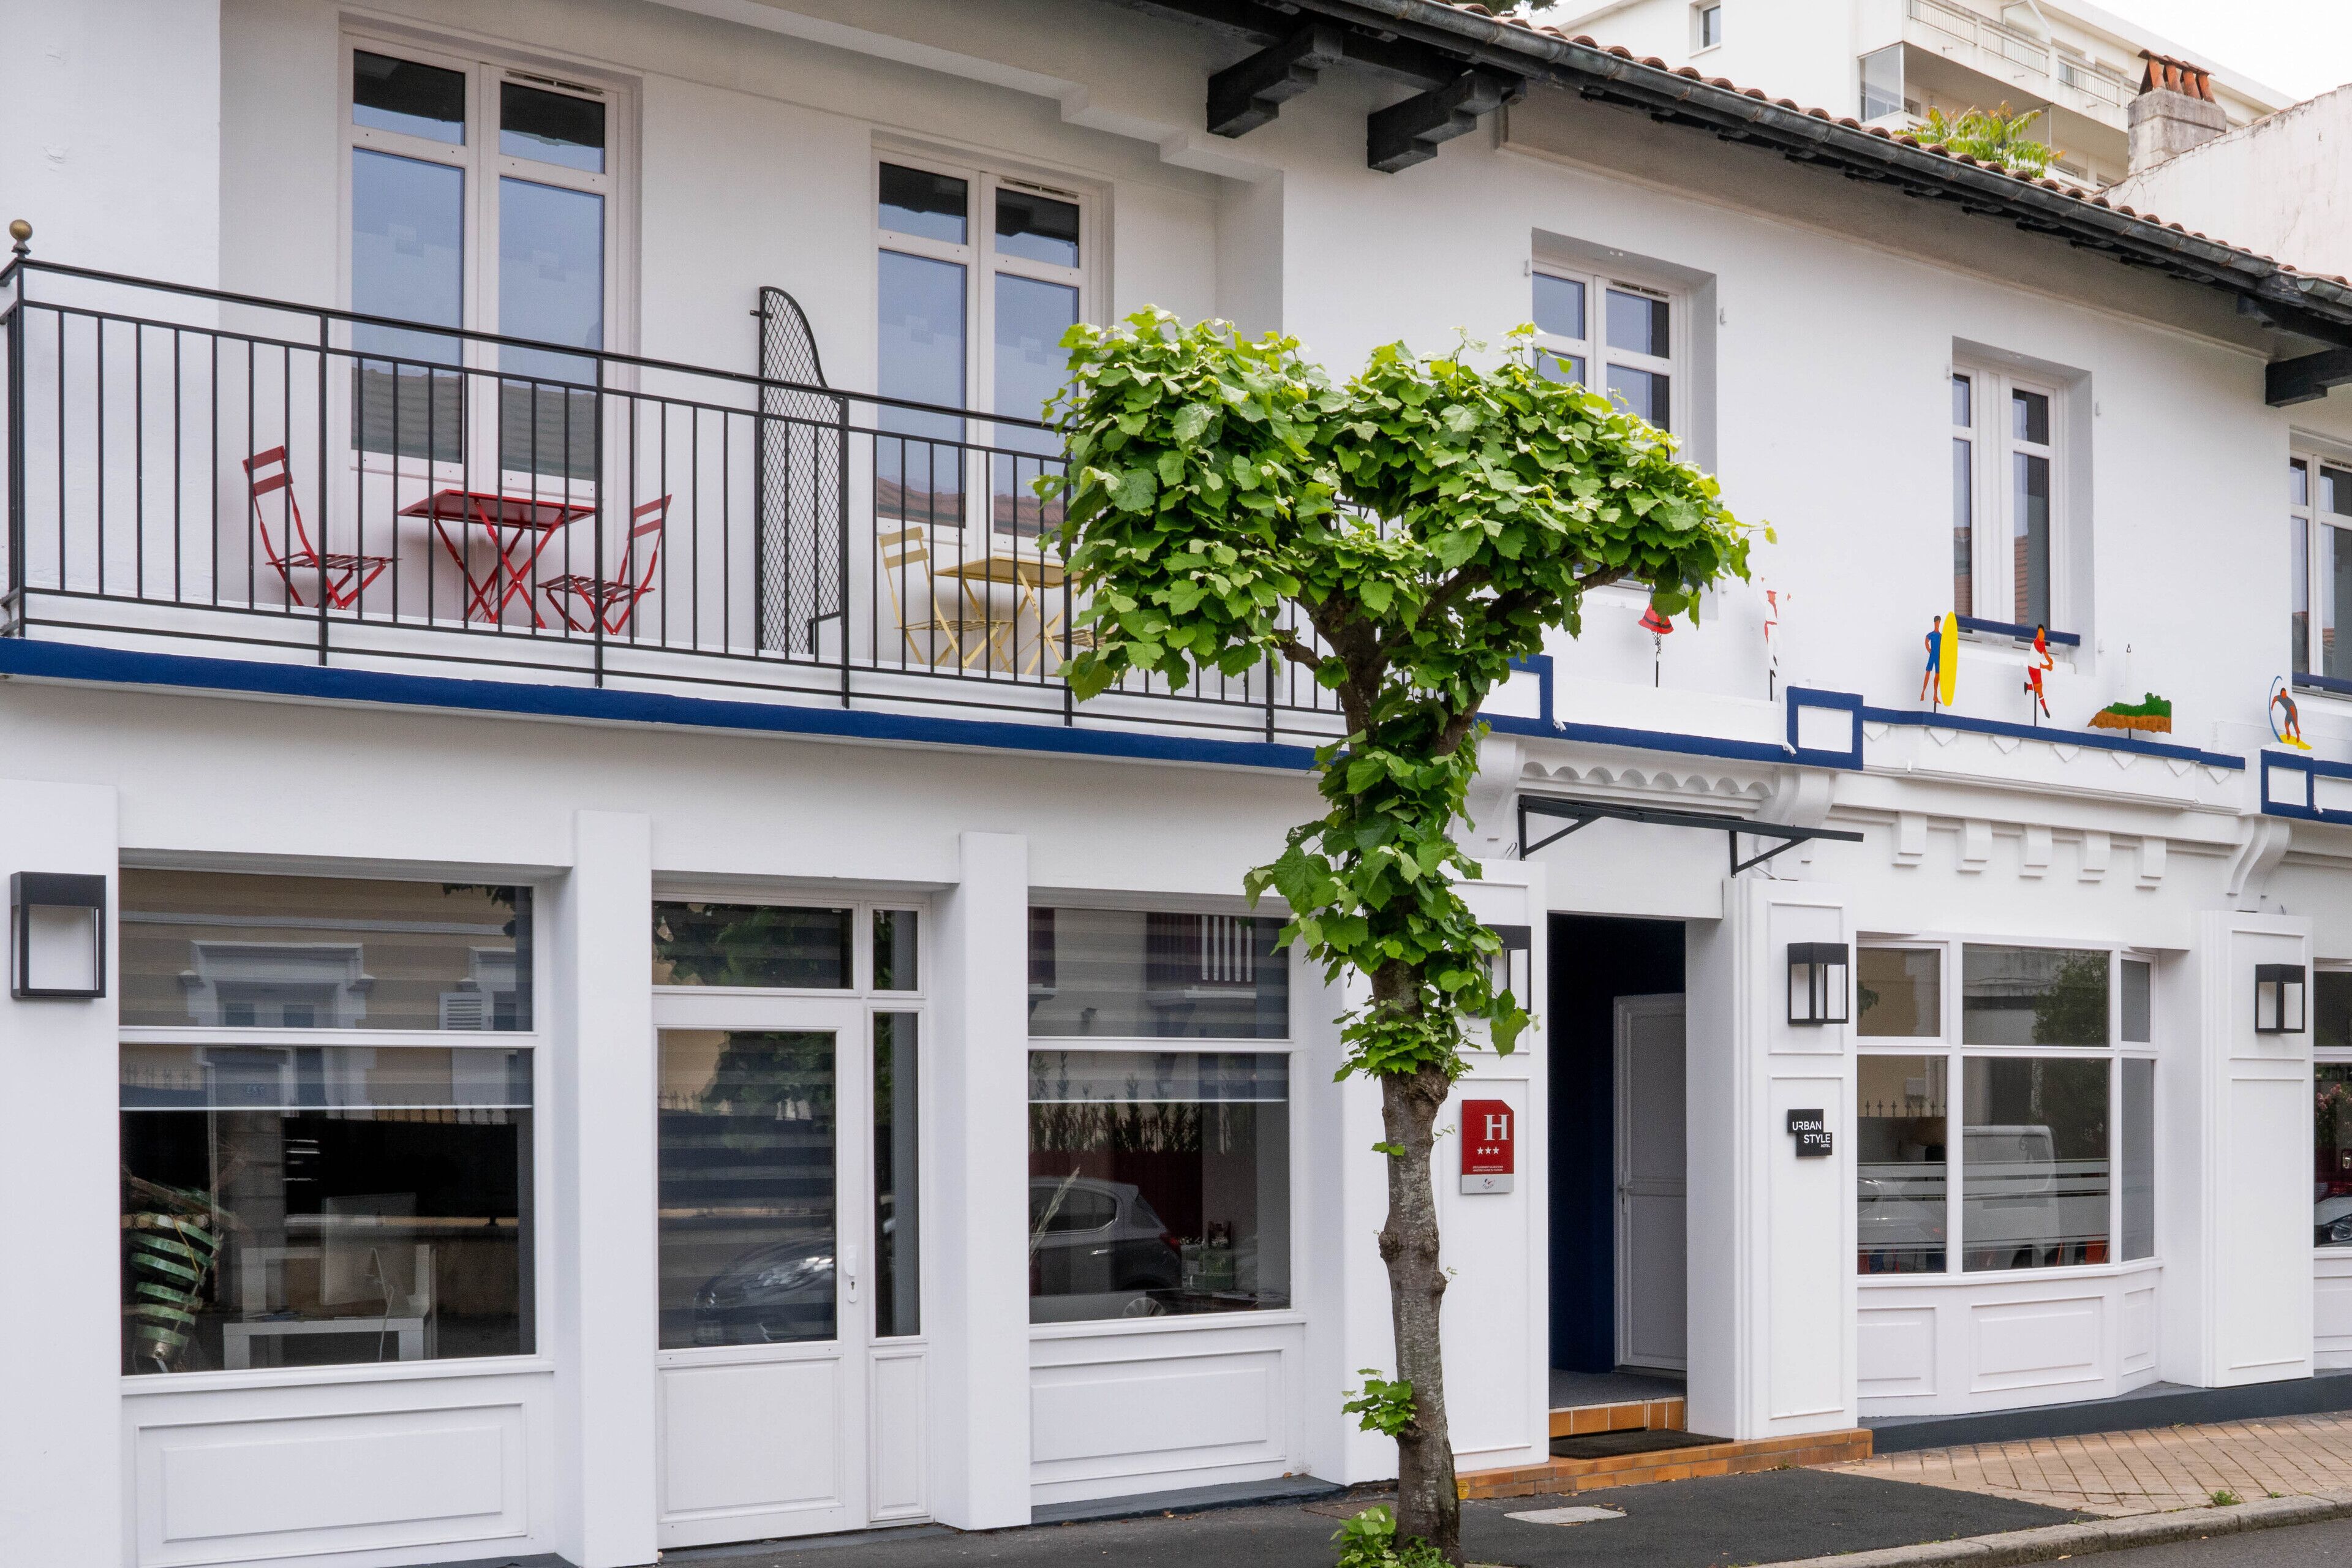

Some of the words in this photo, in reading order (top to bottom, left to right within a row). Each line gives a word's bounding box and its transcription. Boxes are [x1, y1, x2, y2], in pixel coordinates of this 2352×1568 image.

[1484, 1114, 1509, 1140] H
[1792, 1121, 1822, 1131] URBAN
[1803, 1134, 1831, 1144] STYLE
